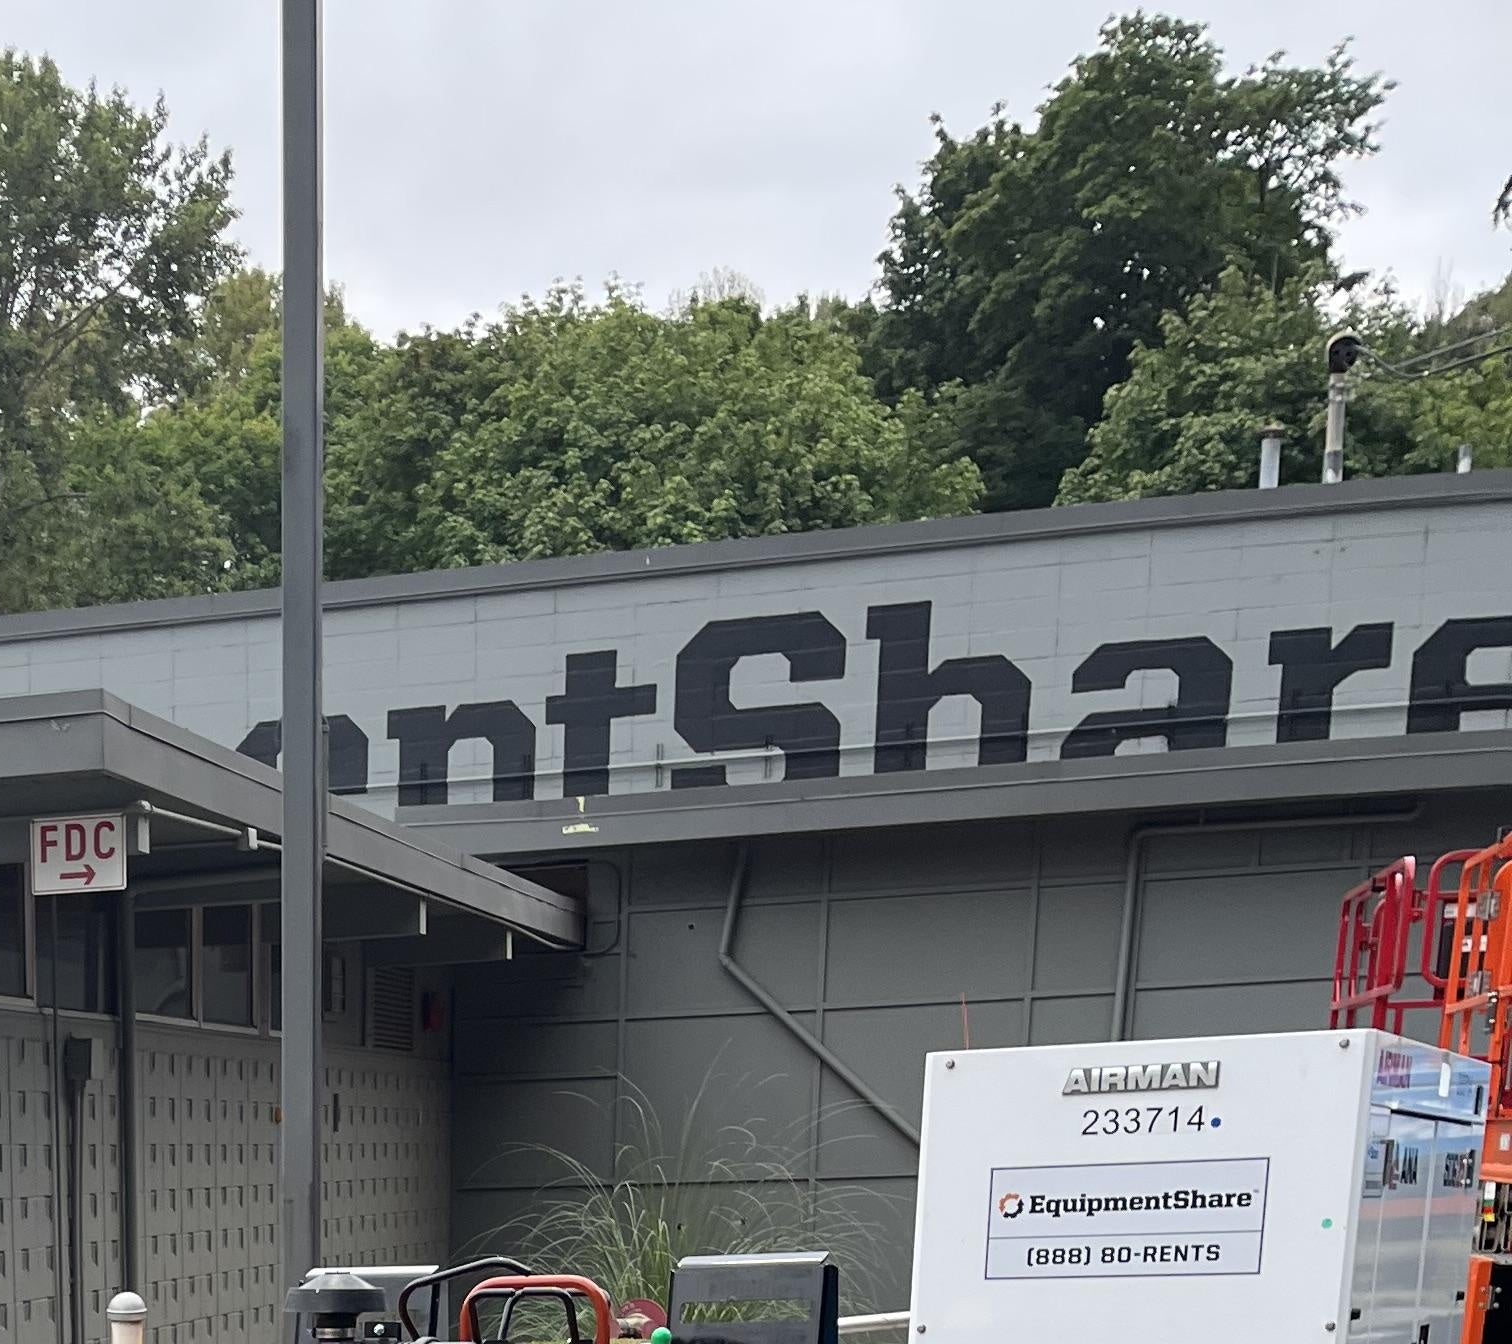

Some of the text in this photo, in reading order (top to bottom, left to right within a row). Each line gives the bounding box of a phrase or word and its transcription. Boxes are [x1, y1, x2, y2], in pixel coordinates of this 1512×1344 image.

[40, 820, 116, 863] FDC
[1062, 1060, 1221, 1096] AIRMAN
[1081, 1105, 1205, 1136] 233714
[1029, 1189, 1253, 1218] EquipmentShare
[1027, 1244, 1221, 1266] (888) 80-RENTS
